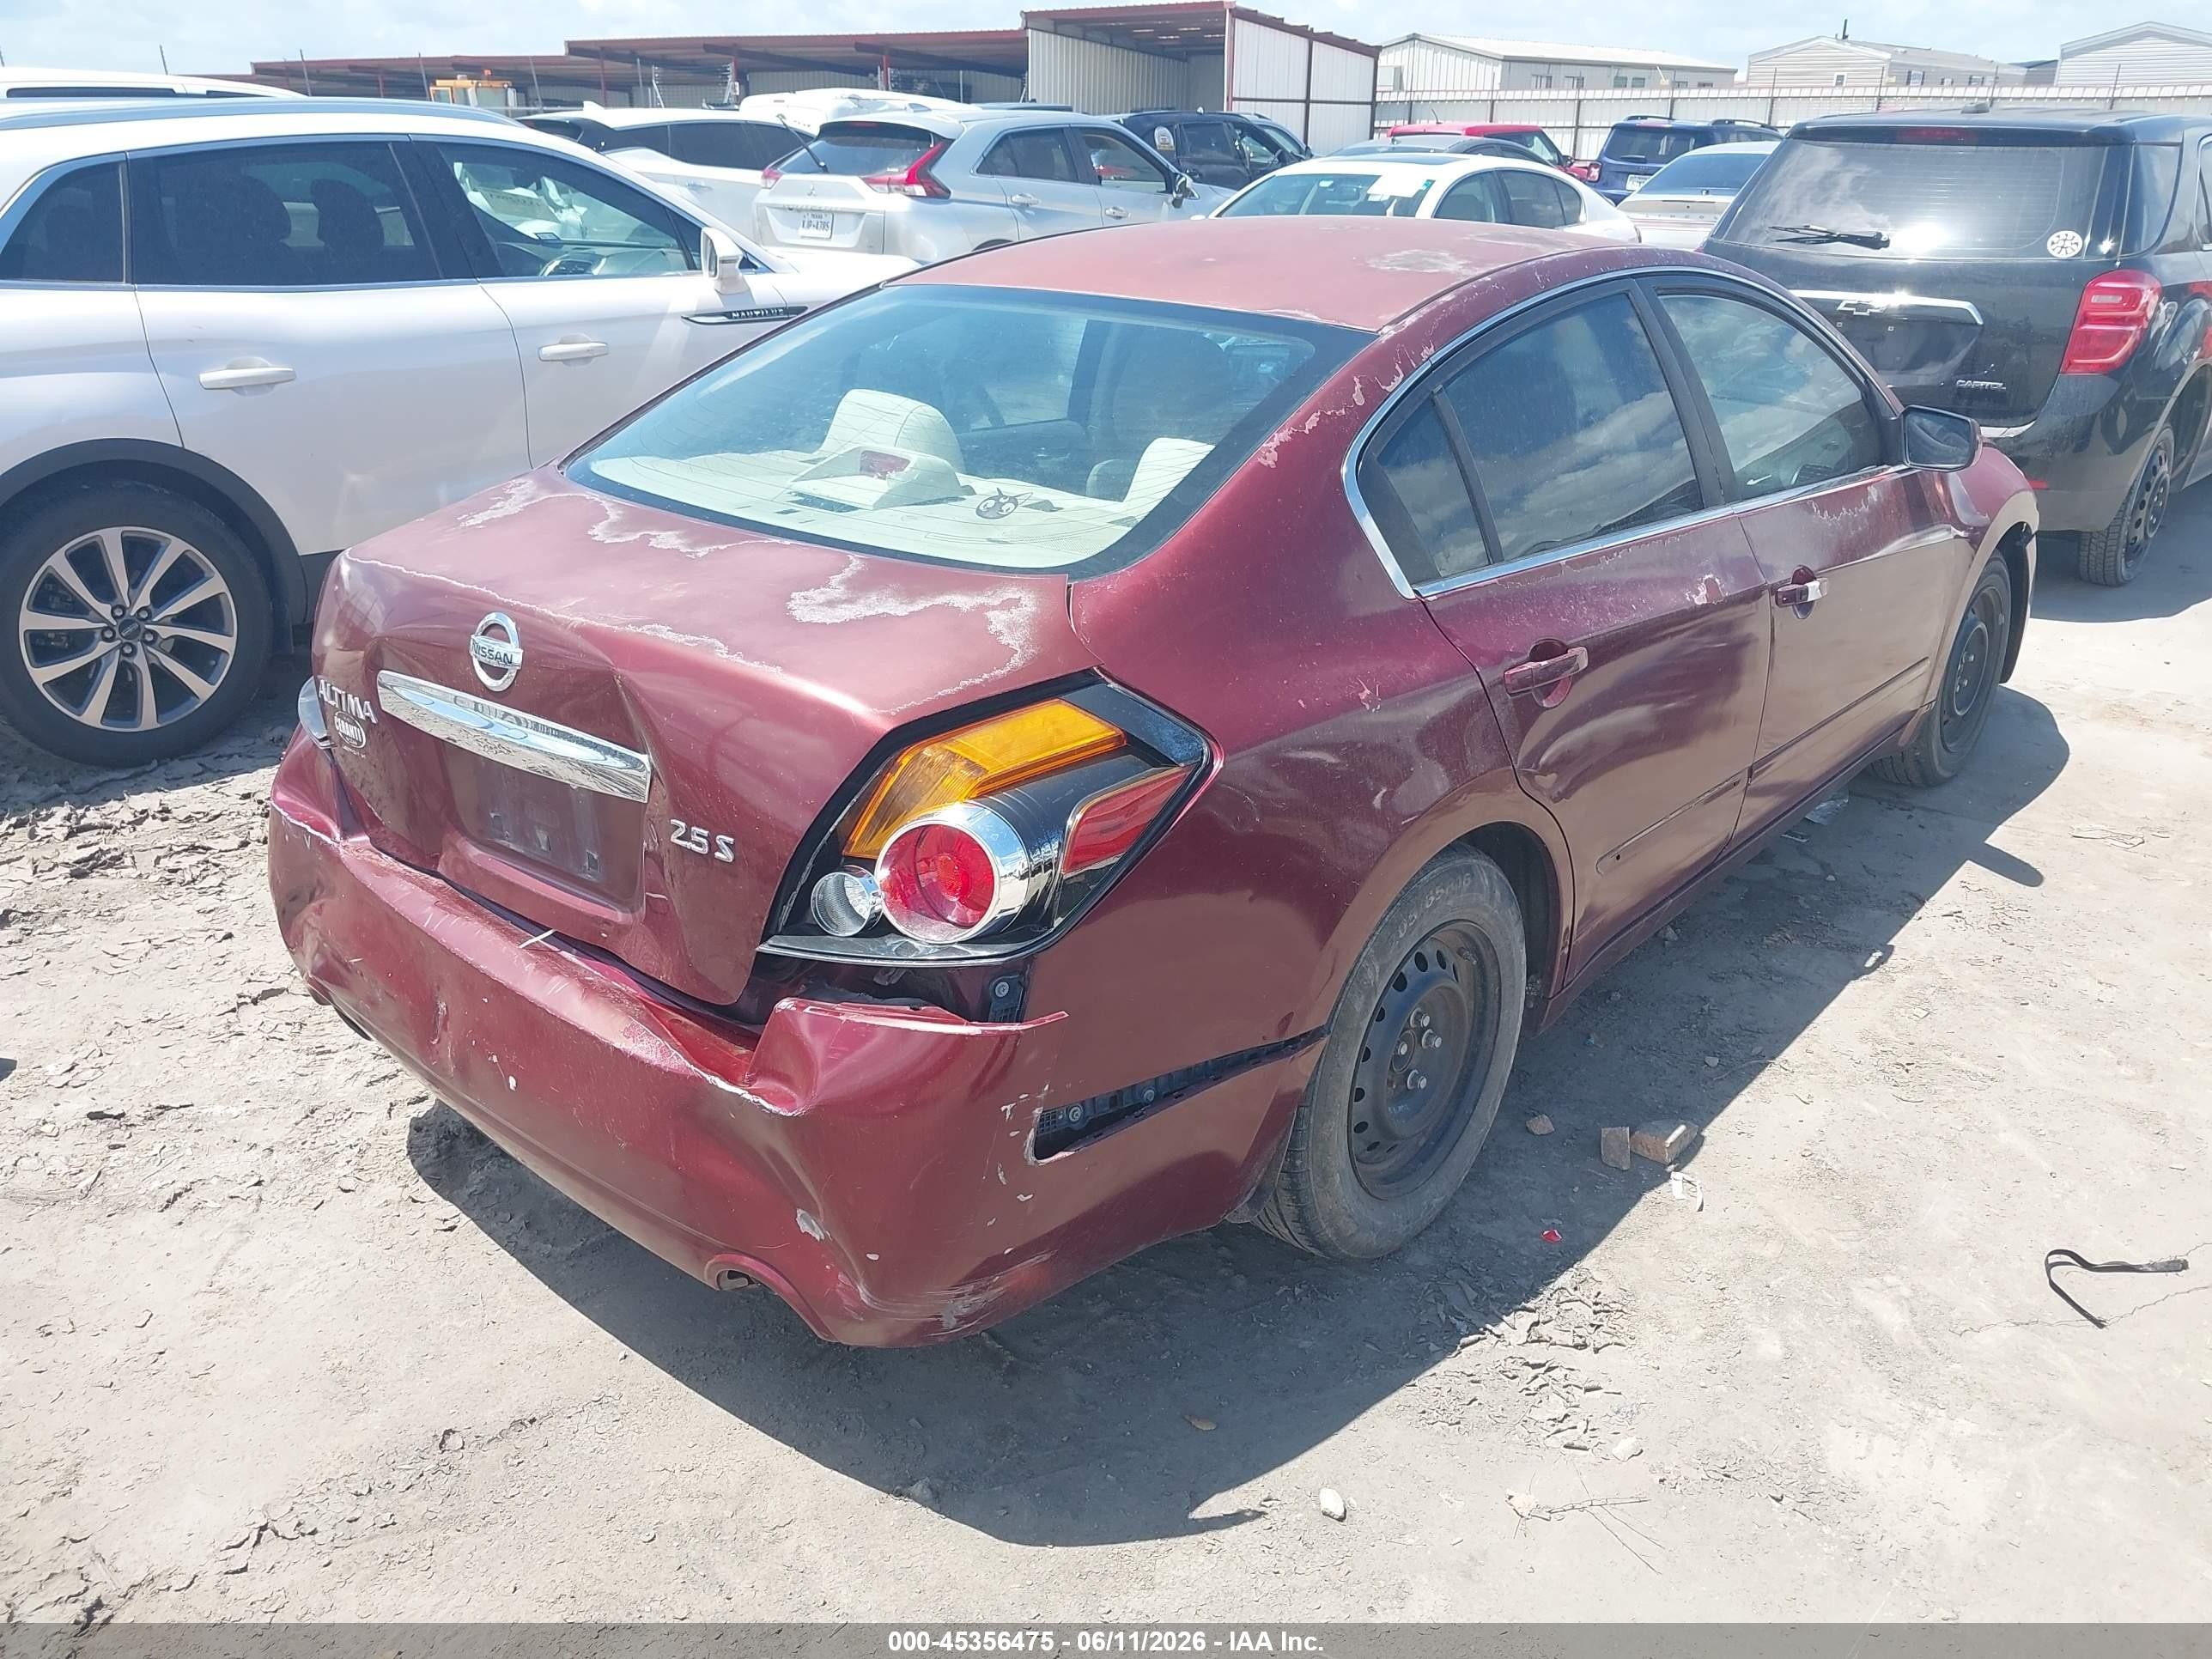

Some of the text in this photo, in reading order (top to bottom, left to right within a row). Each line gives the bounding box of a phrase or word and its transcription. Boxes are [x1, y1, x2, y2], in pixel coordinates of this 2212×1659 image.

[731, 308, 784, 319] NAUTILUS
[472, 641, 514, 665] NISSAN
[319, 679, 378, 724] ALTIMA
[714, 835, 735, 863] S
